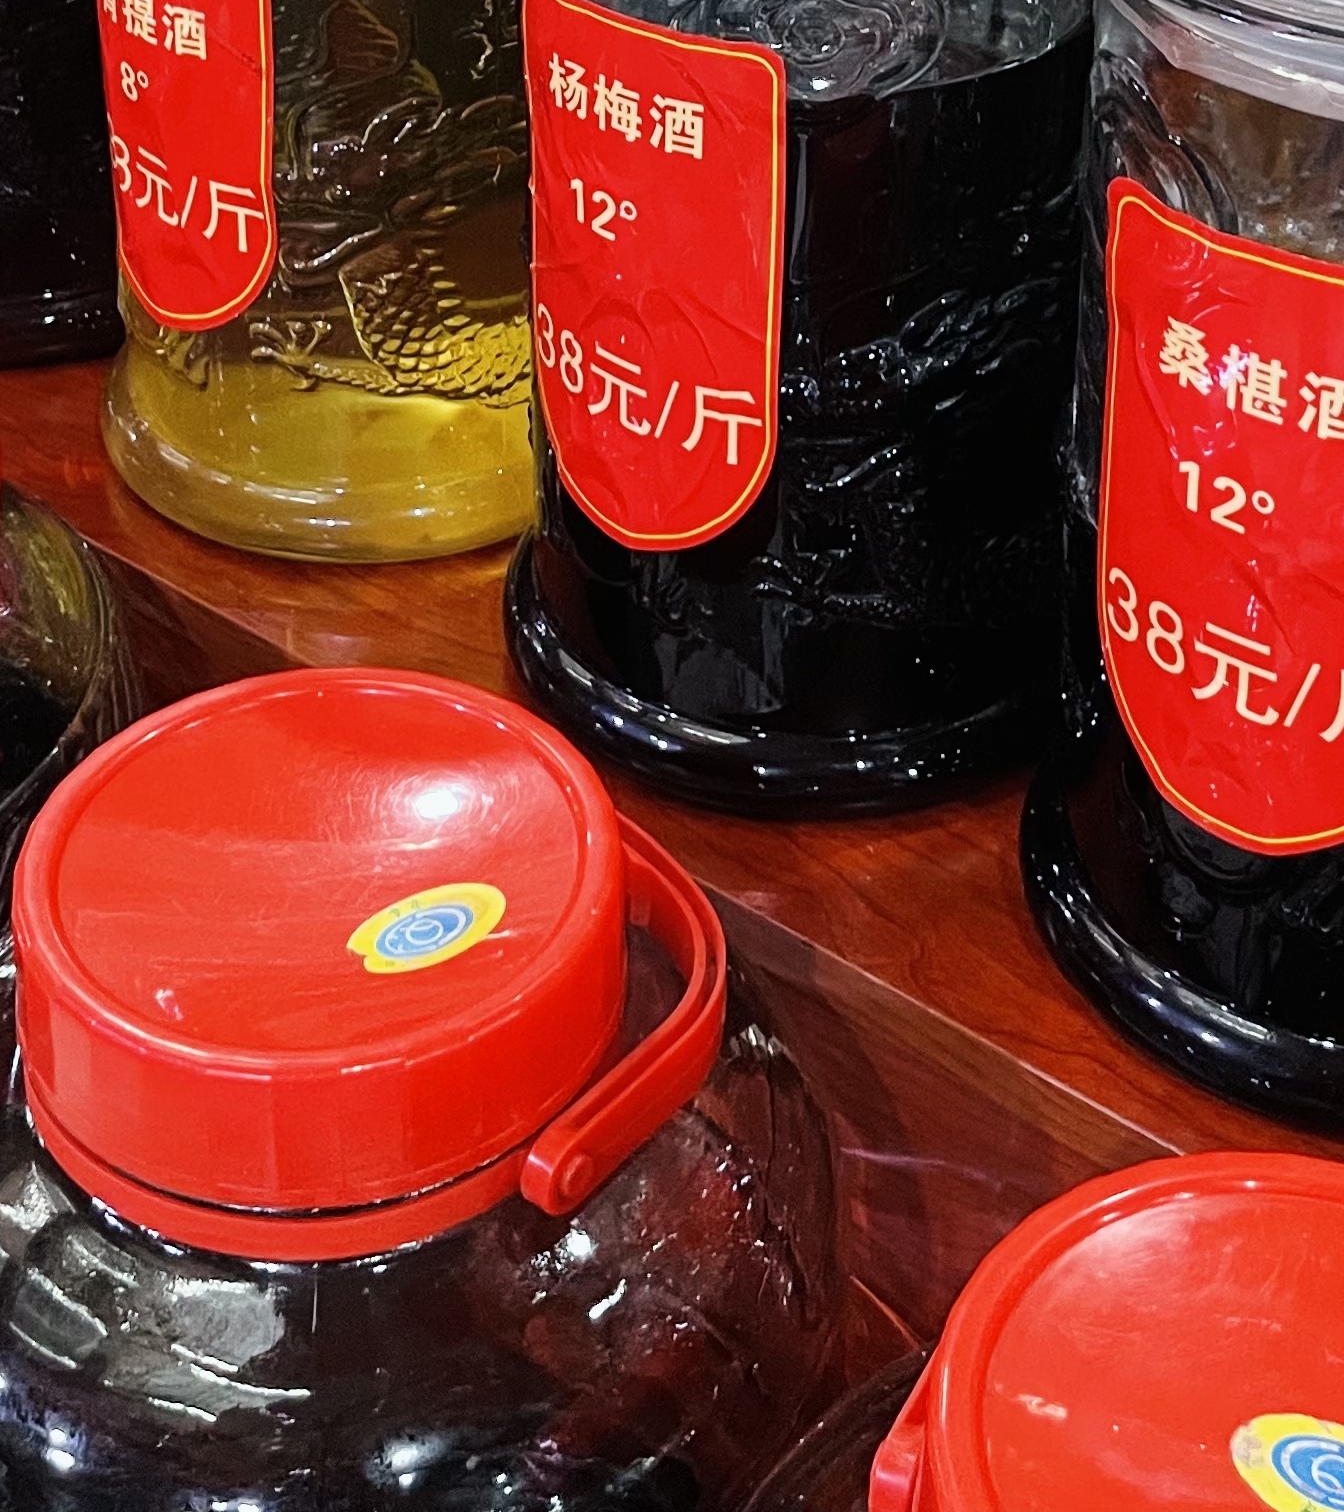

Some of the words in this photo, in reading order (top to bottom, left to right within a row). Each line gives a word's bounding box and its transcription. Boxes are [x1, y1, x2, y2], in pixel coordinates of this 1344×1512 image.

[120, 60, 149, 102] 8°
[548, 51, 705, 160] 杨梅酒
[569, 177, 638, 241] 12°
[536, 301, 763, 466] 38元/斤
[1178, 460, 1275, 535] 12°
